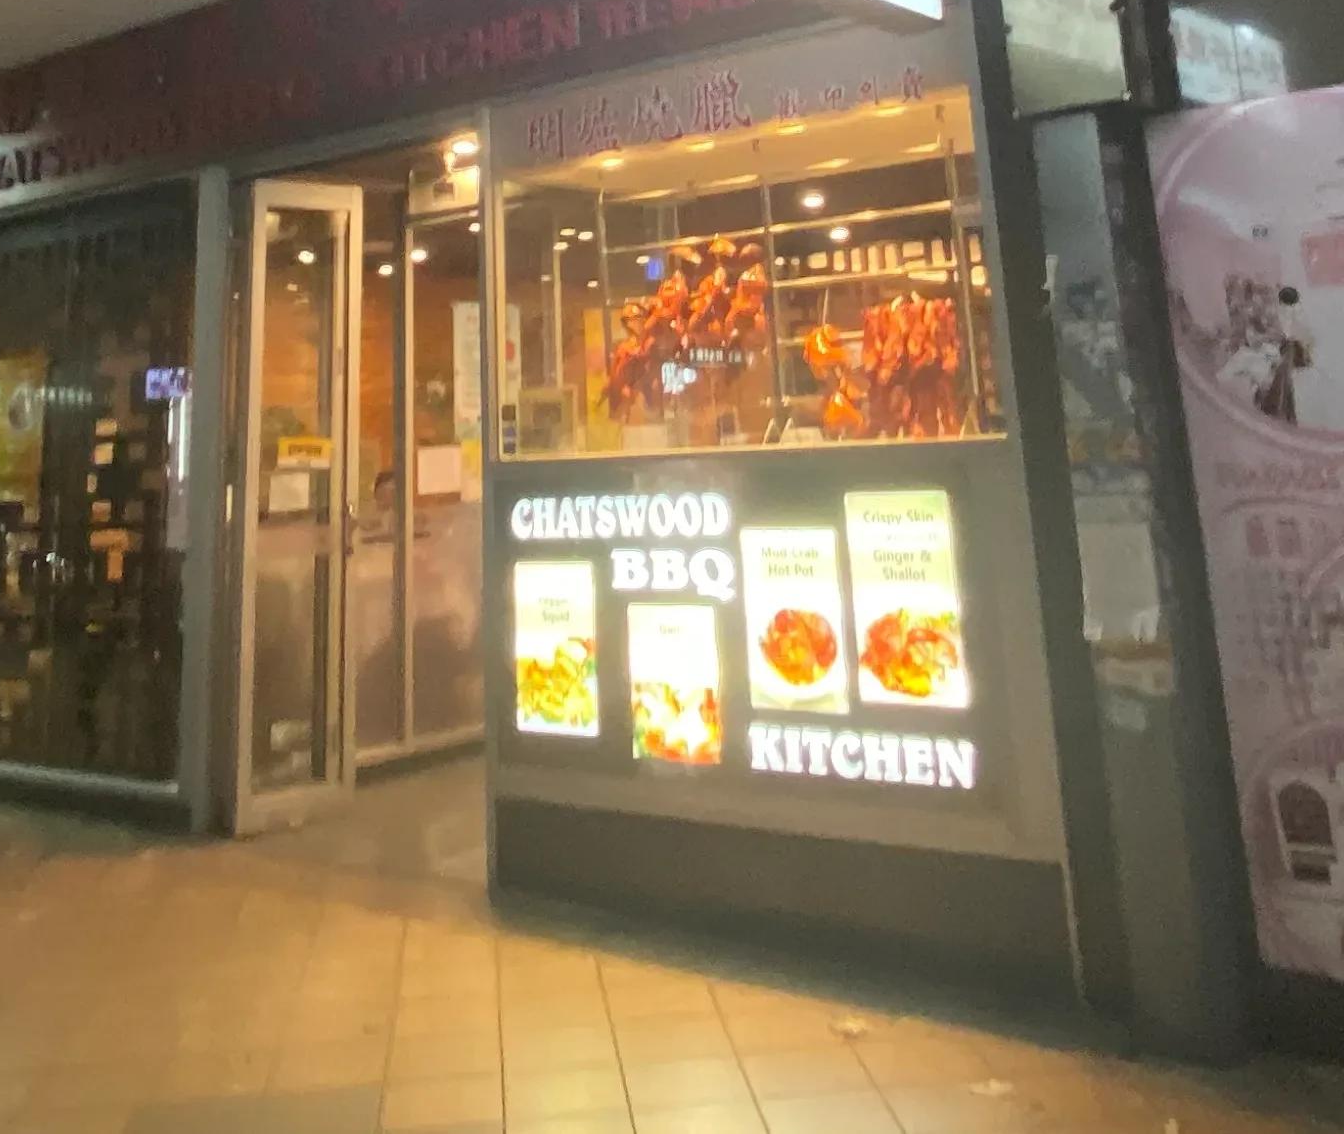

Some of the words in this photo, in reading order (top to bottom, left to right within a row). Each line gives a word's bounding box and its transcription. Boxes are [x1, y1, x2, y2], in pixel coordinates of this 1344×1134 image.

[510, 491, 730, 540] CHATSWOOD
[610, 546, 737, 603] BBQ
[748, 722, 976, 790] KITCHEN
